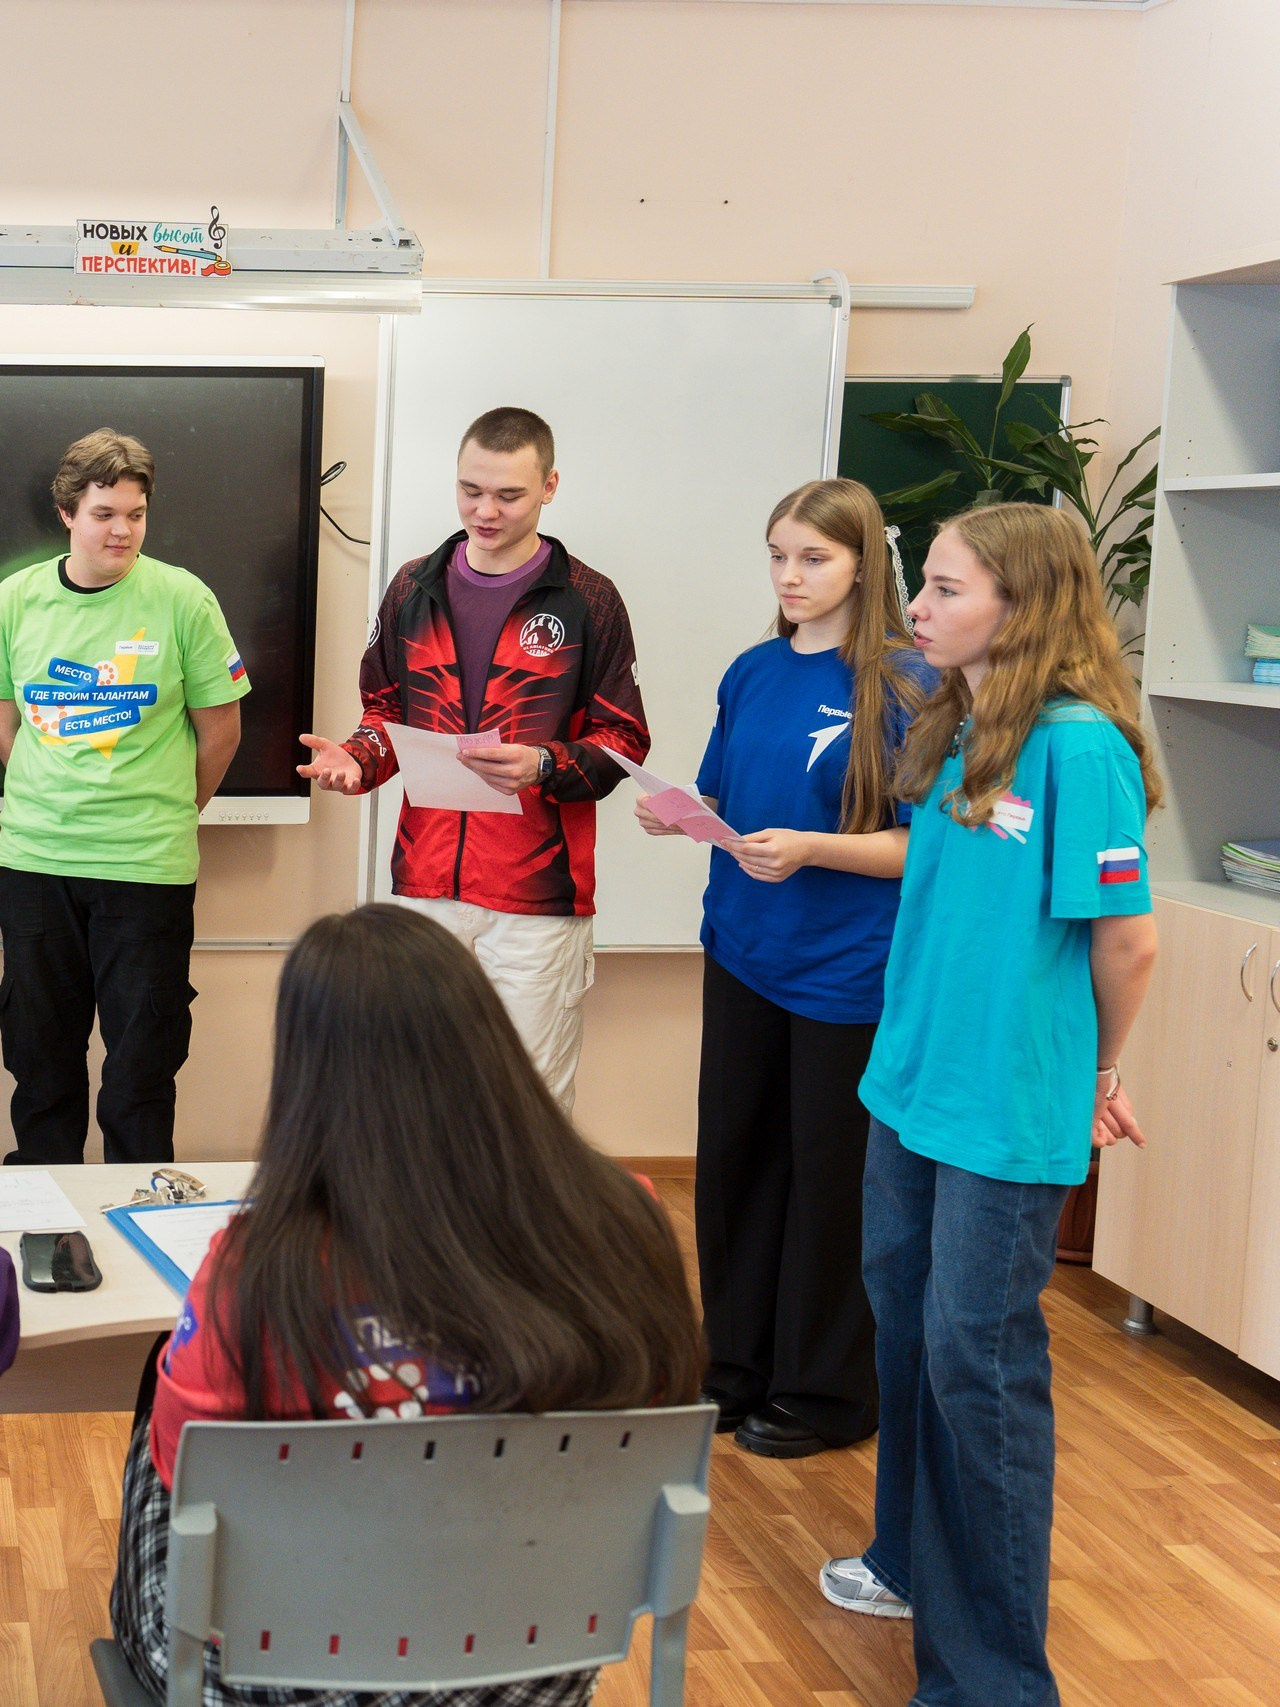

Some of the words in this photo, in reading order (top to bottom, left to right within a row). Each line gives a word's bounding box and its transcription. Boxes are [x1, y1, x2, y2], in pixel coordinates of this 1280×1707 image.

[83, 223, 148, 241] НОВЫХ
[153, 222, 204, 244] высот
[118, 243, 135, 256] и
[82, 256, 197, 275] ПЕРСПЕКТИВ!
[54, 664, 93, 683] МЕСТО,
[30, 690, 50, 701] ГДЕ
[52, 691, 89, 701] ТВОИМ
[92, 690, 150, 701] ТАЛАНТАМ
[64, 720, 91, 731] ЕСТЬ
[93, 710, 132, 727] МЕСТО!
[817, 704, 853, 720] Первые
